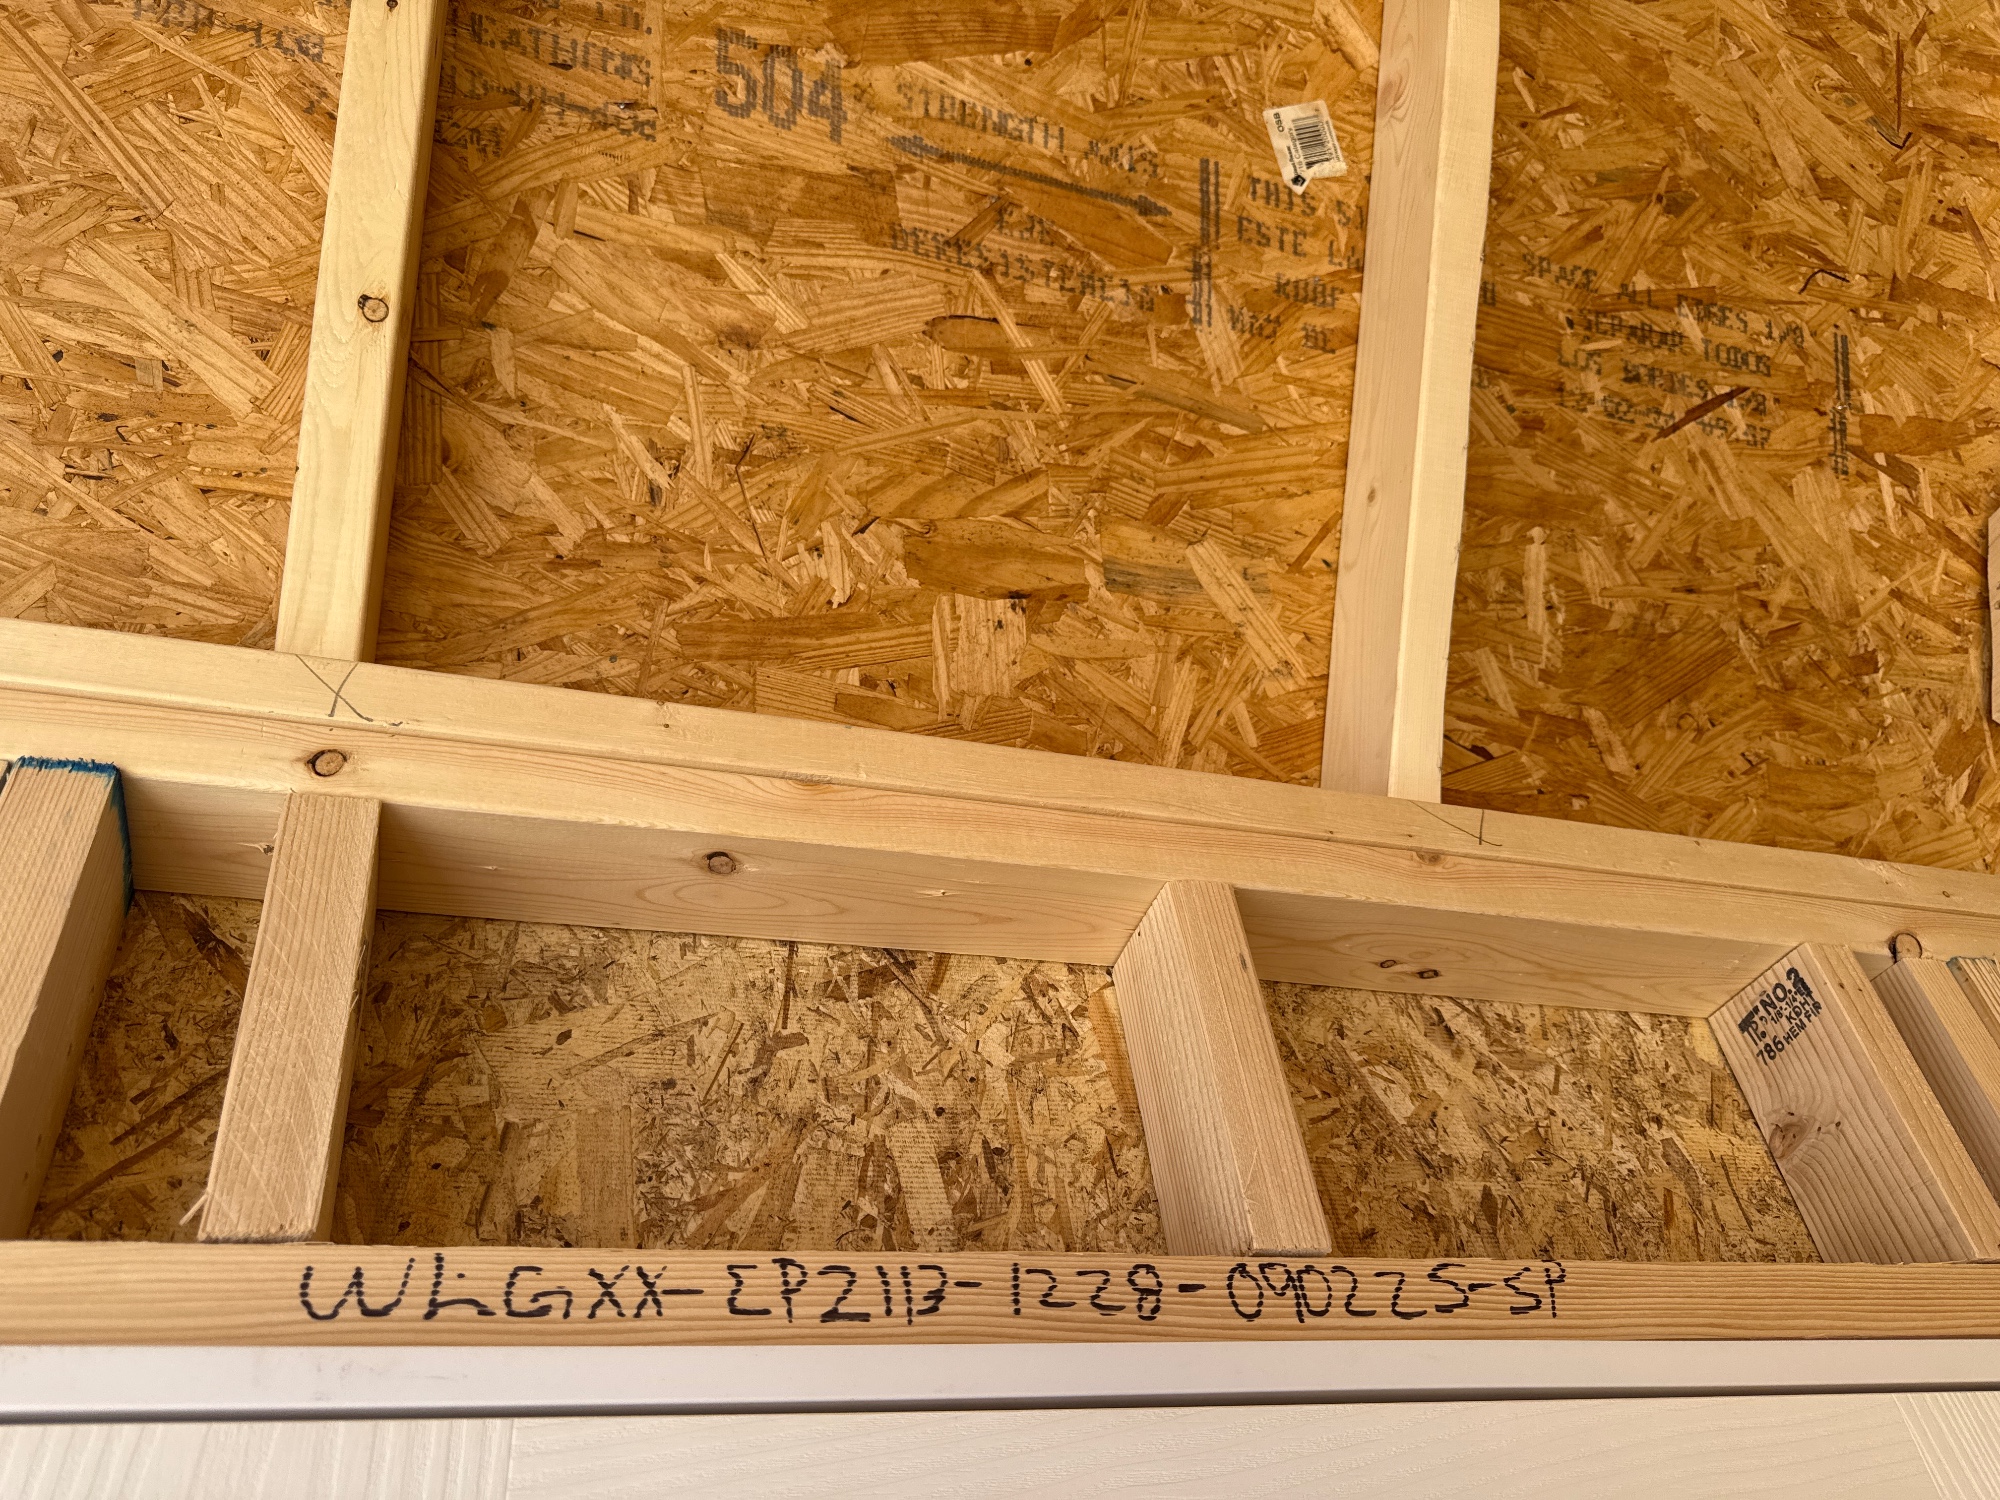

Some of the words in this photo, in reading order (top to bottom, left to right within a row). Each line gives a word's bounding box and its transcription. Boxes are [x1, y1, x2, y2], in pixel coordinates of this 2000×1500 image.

[715, 27, 848, 145] 504
[896, 73, 1064, 154] STRENGTH
[1273, 112, 1285, 133] OSB
[1288, 127, 1301, 160] Category
[1247, 175, 1317, 217] THIS
[1335, 199, 1365, 231] SI
[1236, 214, 1308, 258] ESTE
[1521, 251, 1599, 294] SPACE
[1617, 280, 1661, 311] ALL
[1700, 336, 1772, 378] TODOS
[1756, 1034, 1785, 1067] 786
[1782, 1019, 1807, 1046] HEM
[1803, 1000, 1823, 1023] FIR
